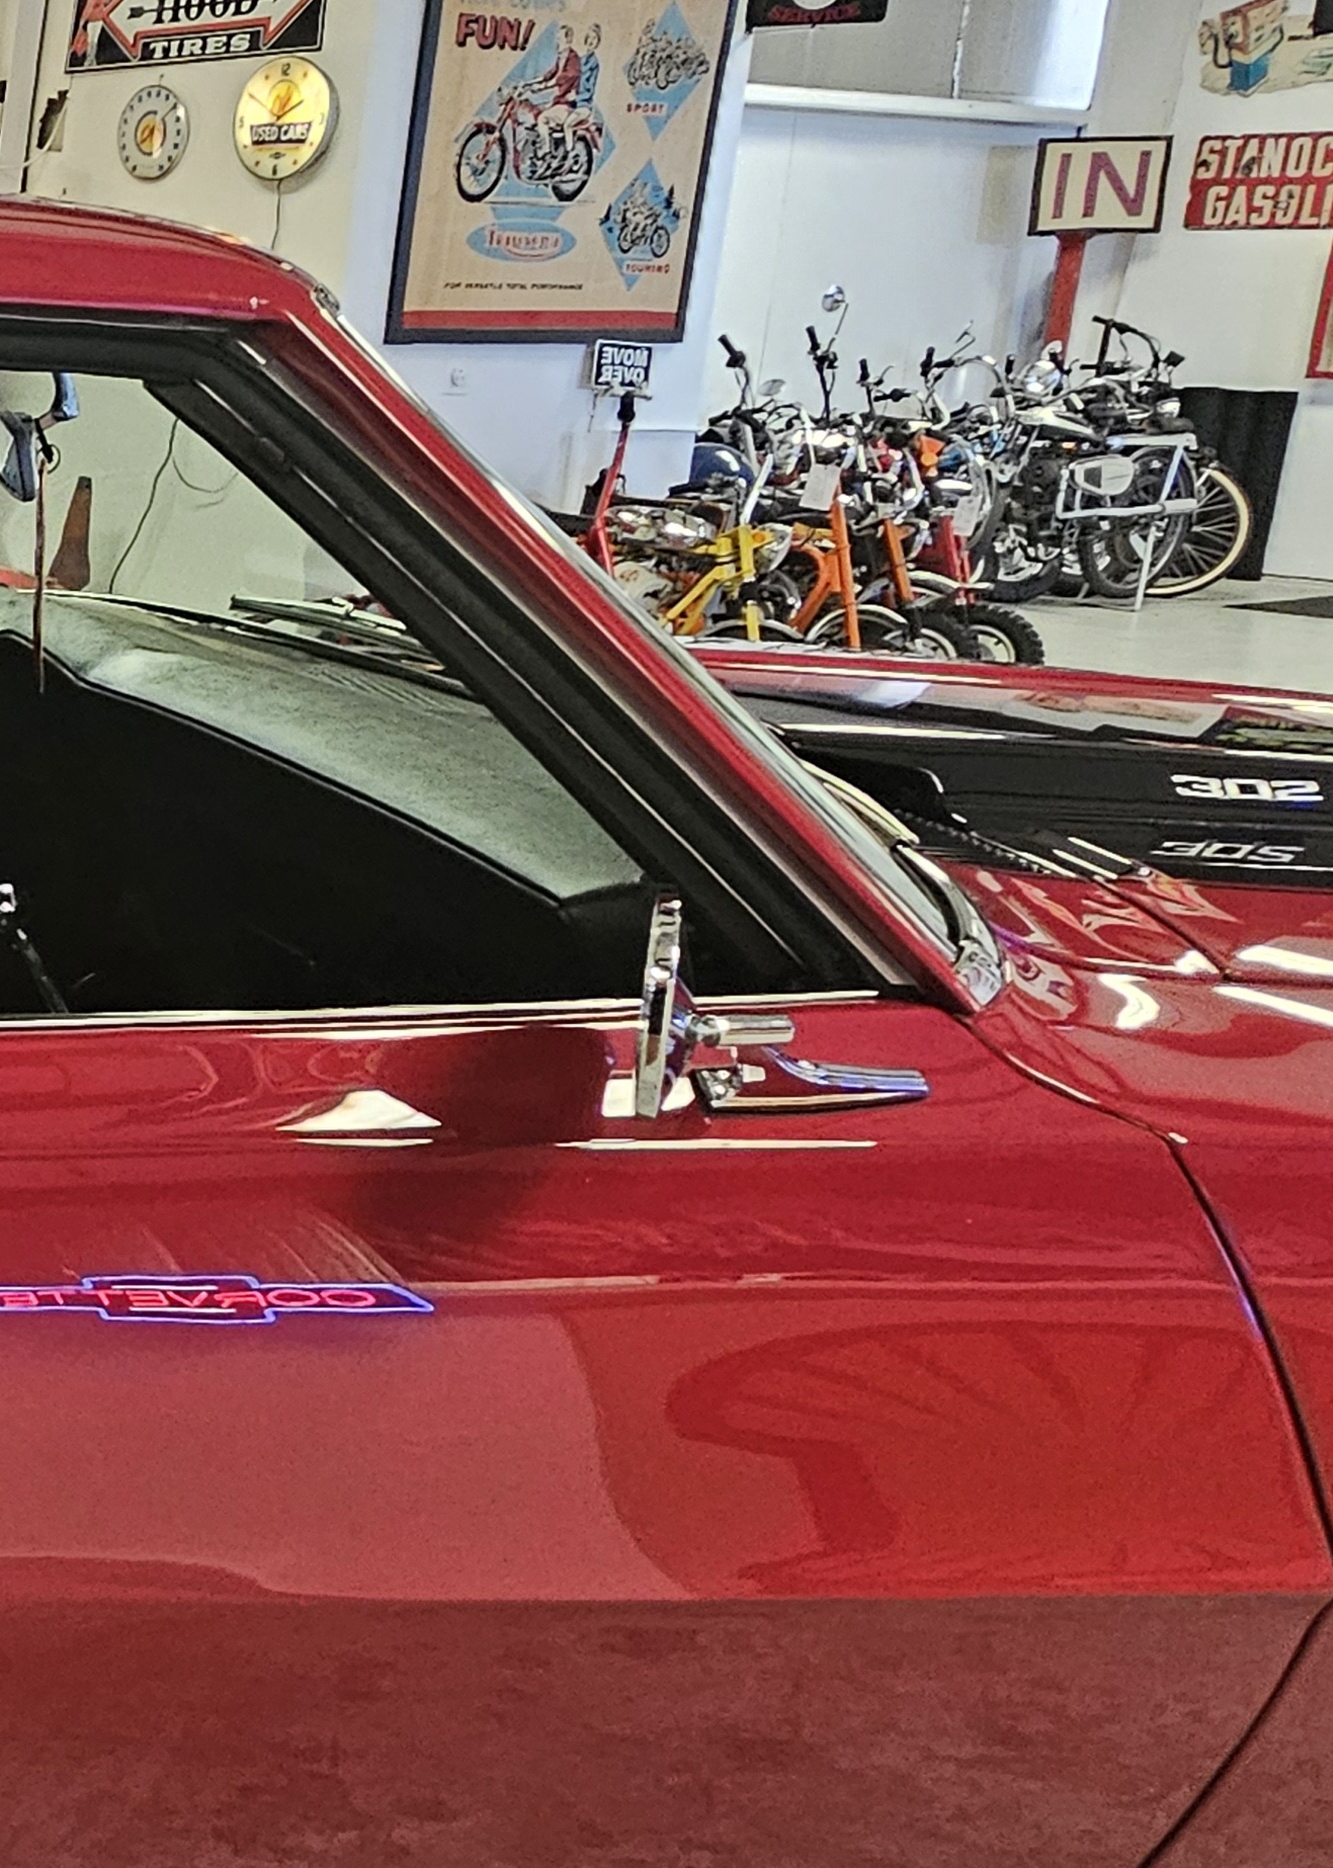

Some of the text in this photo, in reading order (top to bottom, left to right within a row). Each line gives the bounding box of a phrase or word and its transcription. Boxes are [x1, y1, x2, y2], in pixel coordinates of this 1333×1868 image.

[149, 34, 251, 59] TIRES
[455, 12, 536, 51] FUN!
[253, 123, 309, 142] USED CARS
[1196, 136, 1333, 179] STANOC
[1051, 149, 1152, 219] IN
[1170, 774, 1323, 801] 302
